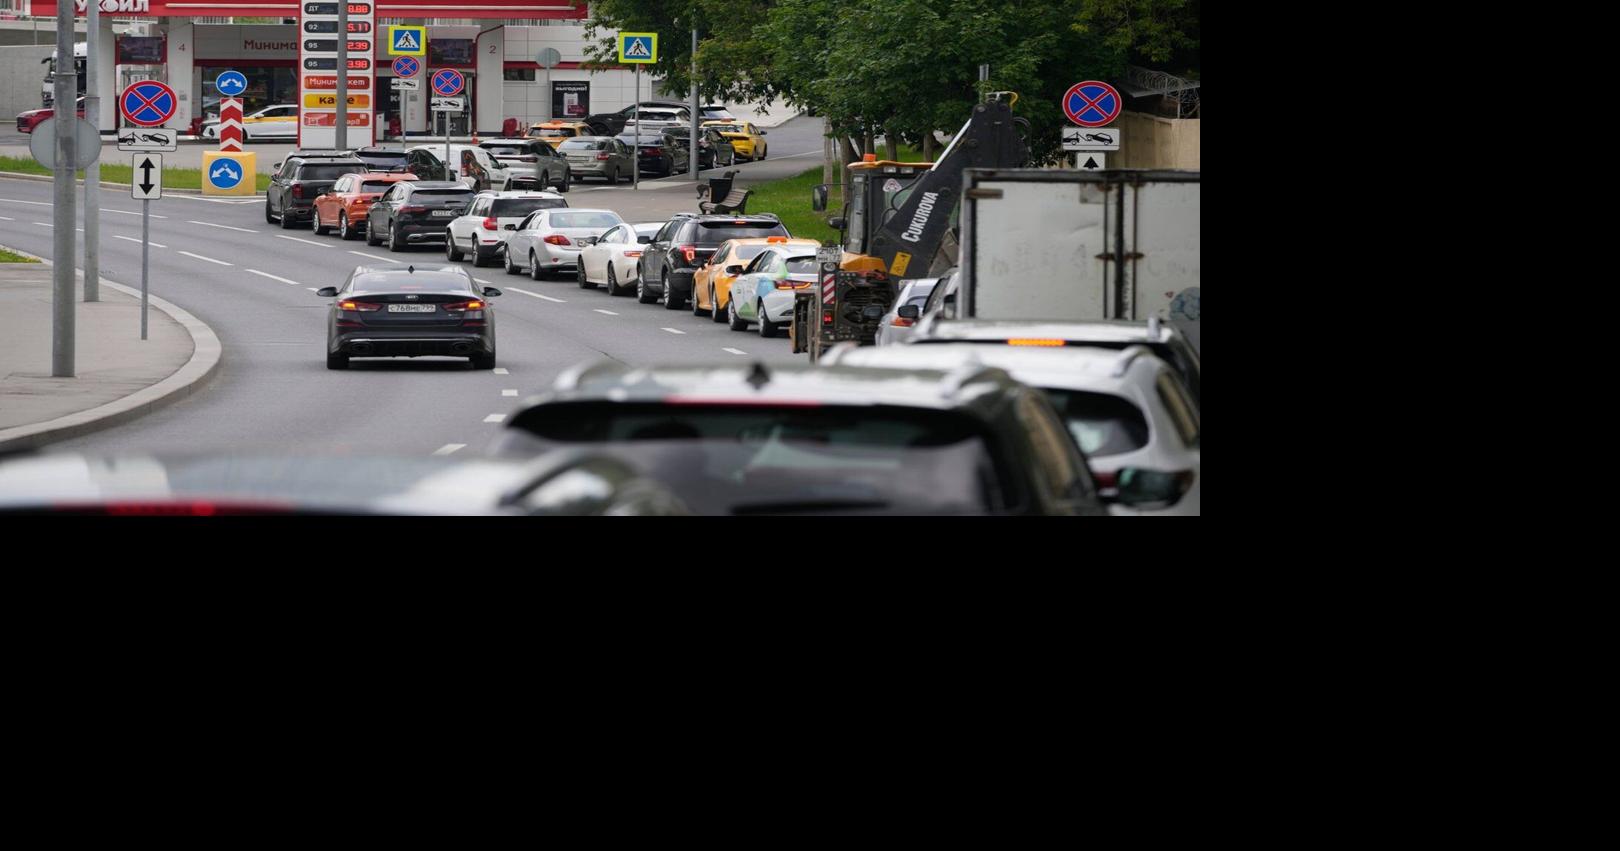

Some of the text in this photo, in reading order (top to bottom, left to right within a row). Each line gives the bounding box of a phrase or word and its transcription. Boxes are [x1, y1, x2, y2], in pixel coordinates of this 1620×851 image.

[178, 43, 185, 51] 4
[244, 39, 298, 50] Минима
[489, 45, 496, 54] 2
[309, 77, 365, 86] Минимкет
[319, 96, 355, 105] кае
[901, 191, 939, 243] CUKUROVA
